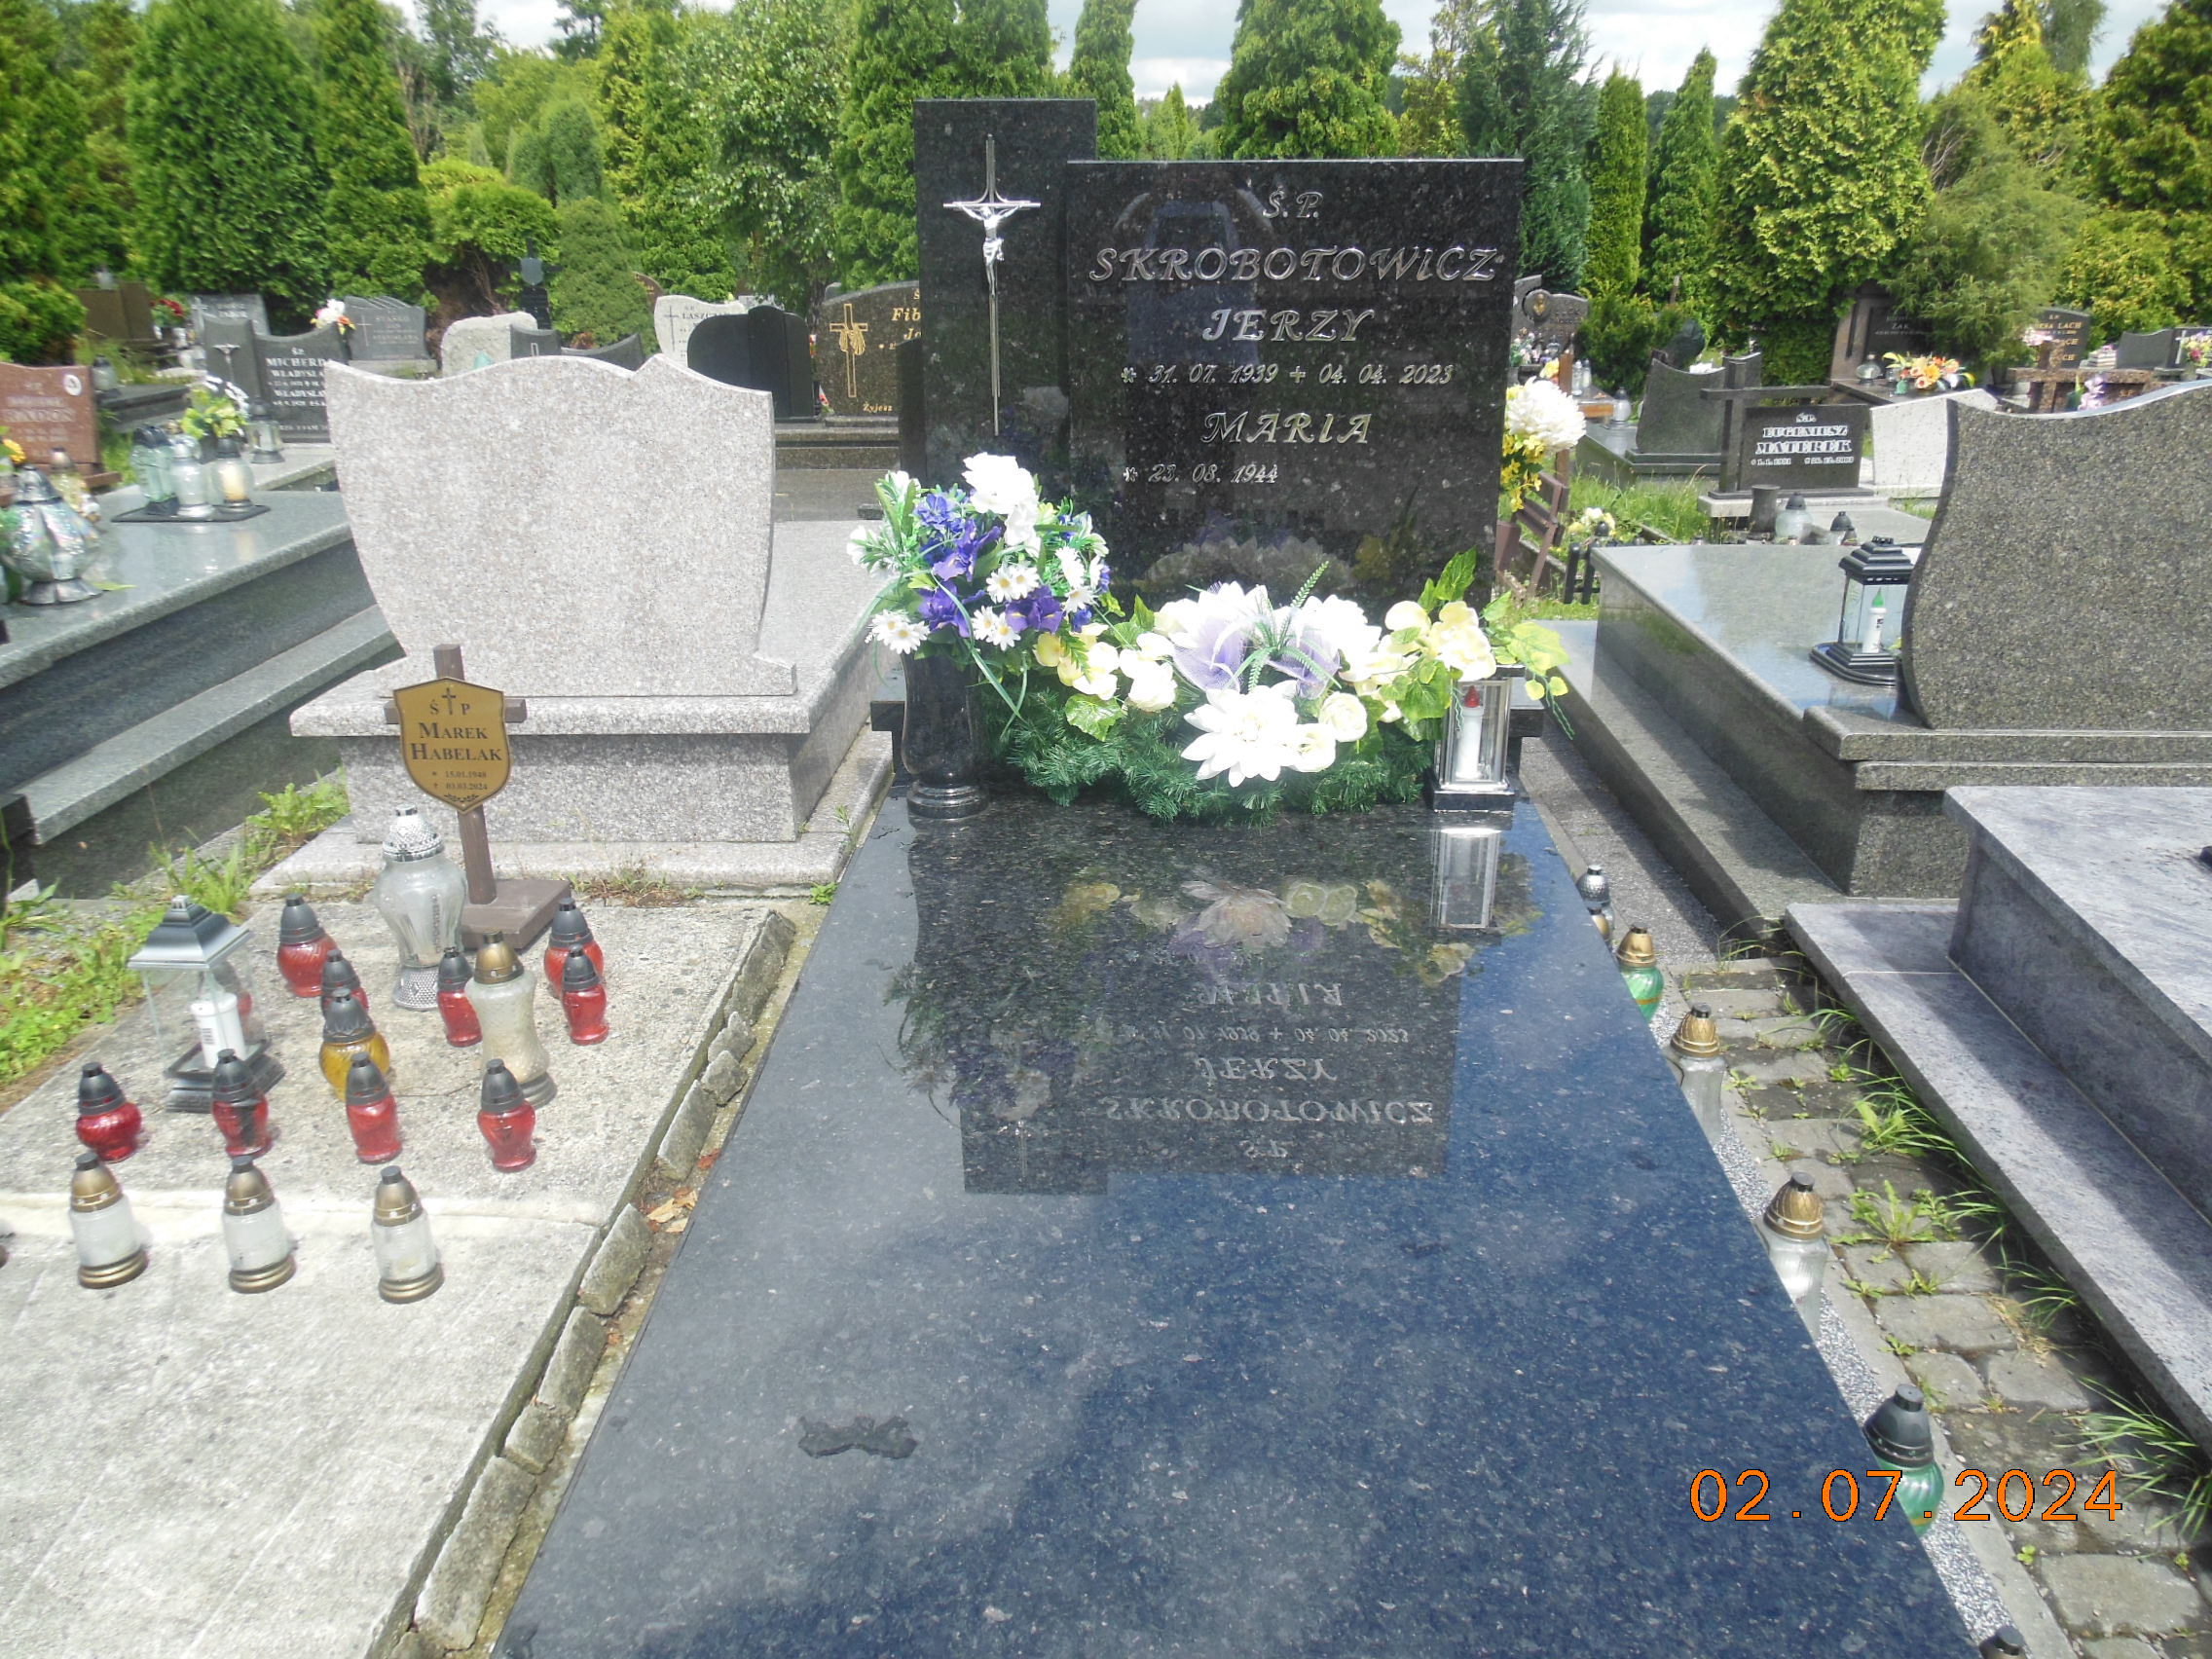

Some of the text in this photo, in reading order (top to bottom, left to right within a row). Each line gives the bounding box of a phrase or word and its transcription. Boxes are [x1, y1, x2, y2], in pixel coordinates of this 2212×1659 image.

[1263, 187, 1323, 218] Ś. P.
[1088, 245, 1498, 281] SKROBOTOWICZ
[1202, 309, 1376, 342] JERZY
[1189, 364, 1218, 384] 07.
[1229, 363, 1279, 385] 1939
[1319, 363, 1347, 385] 04.
[1358, 363, 1387, 385] 04.
[1398, 363, 1455, 385] 2023
[1201, 411, 1373, 444] MARIA
[1762, 425, 1848, 438] EUGENIUSZ
[1755, 440, 1852, 455] MATEREK
[1192, 463, 1221, 483] 08.
[1230, 462, 1279, 484] 1944
[419, 722, 489, 739] MAREK
[411, 743, 502, 761] HABELAK
